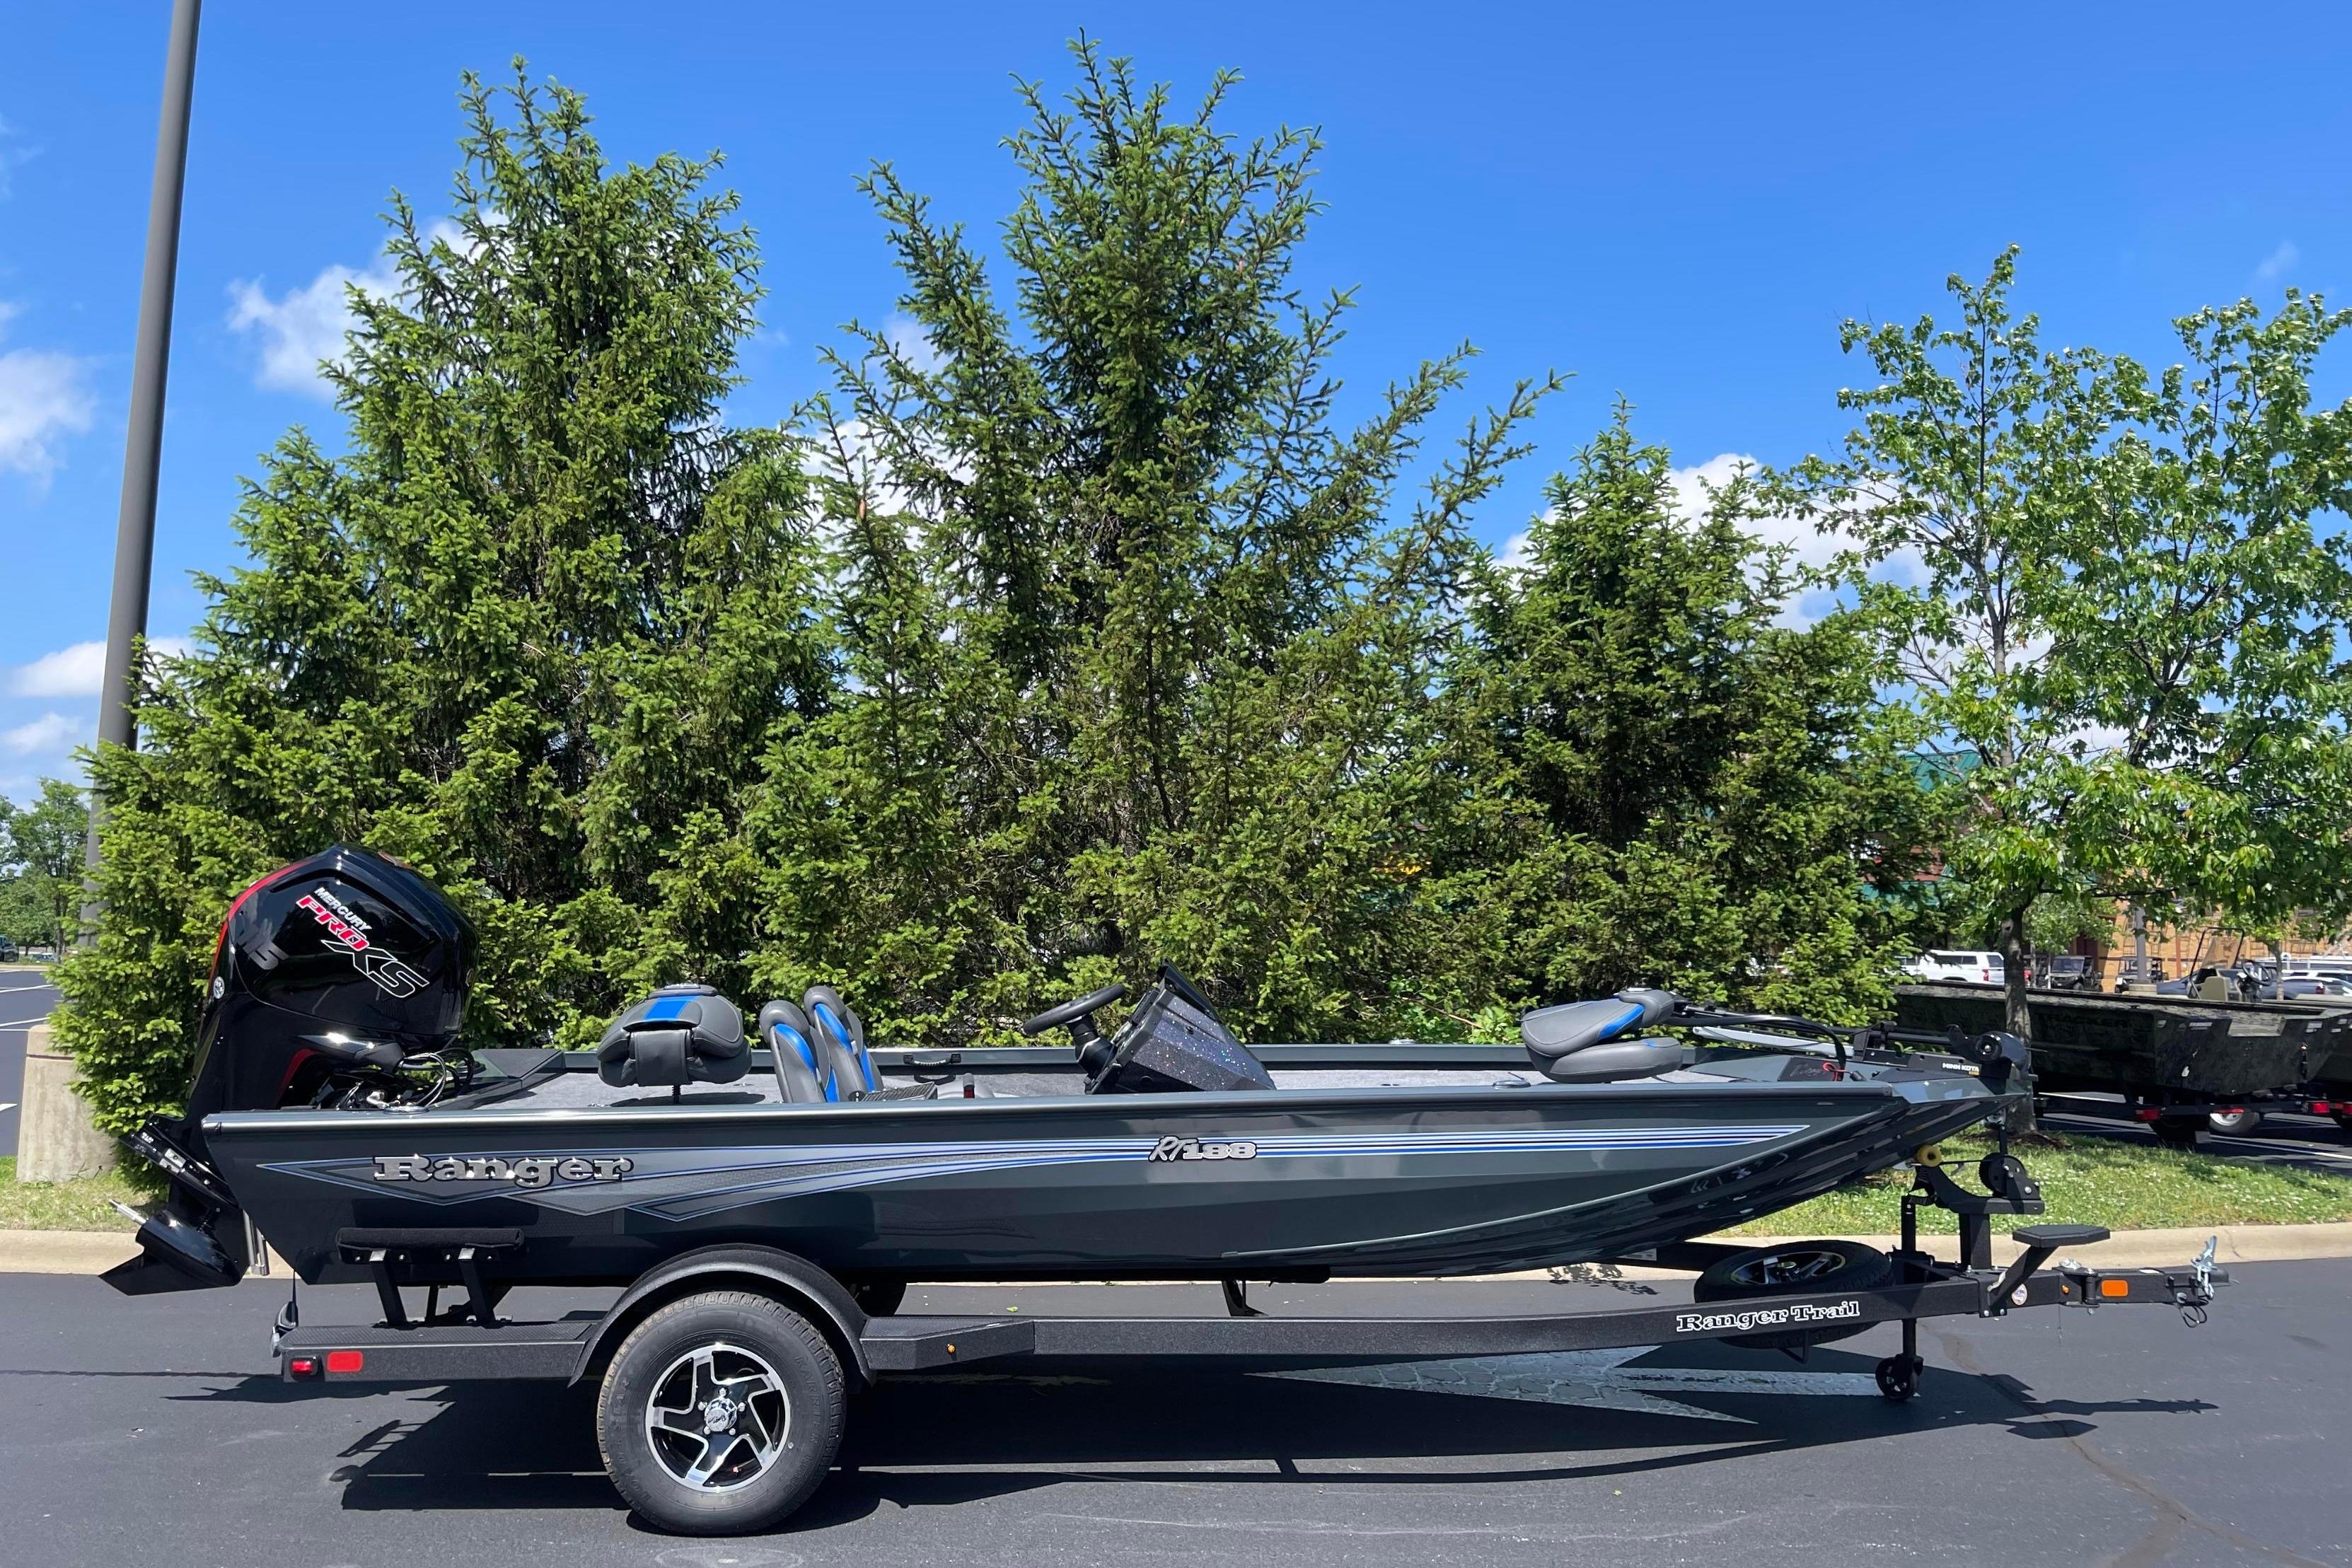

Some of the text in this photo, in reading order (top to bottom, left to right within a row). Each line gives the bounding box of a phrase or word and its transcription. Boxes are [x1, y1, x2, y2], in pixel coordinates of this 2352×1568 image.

[296, 895, 369, 951] PRO
[315, 888, 372, 931] MERCURY
[320, 939, 429, 998] XS
[373, 1154, 633, 1188] Ranger
[1676, 1301, 1860, 1332] Ranger Trail
